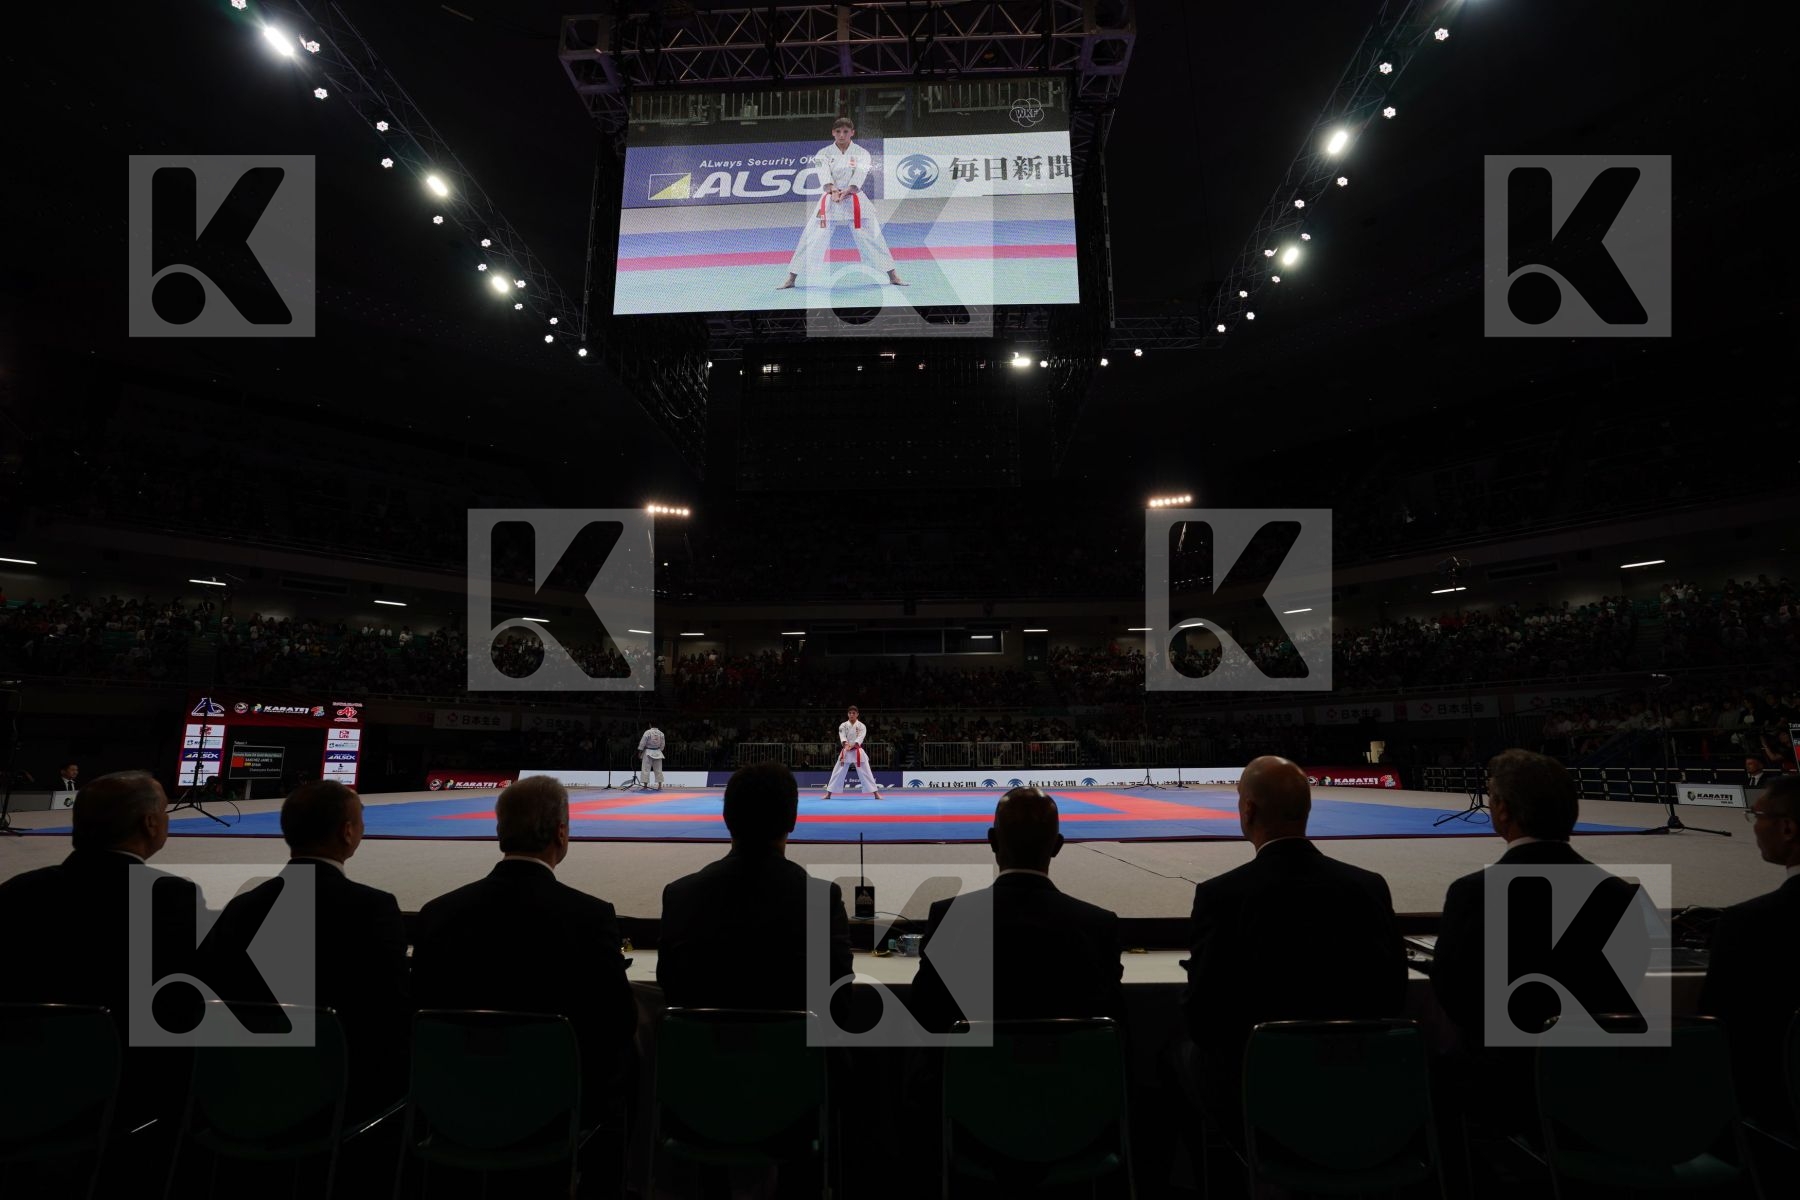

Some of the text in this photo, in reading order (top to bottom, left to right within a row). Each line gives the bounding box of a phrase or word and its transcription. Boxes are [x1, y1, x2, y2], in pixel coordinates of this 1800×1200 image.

[1016, 108, 1038, 118] WKF
[699, 159, 742, 169] ALways
[747, 157, 795, 167] Security
[949, 155, 1073, 182] 毎日新聞
